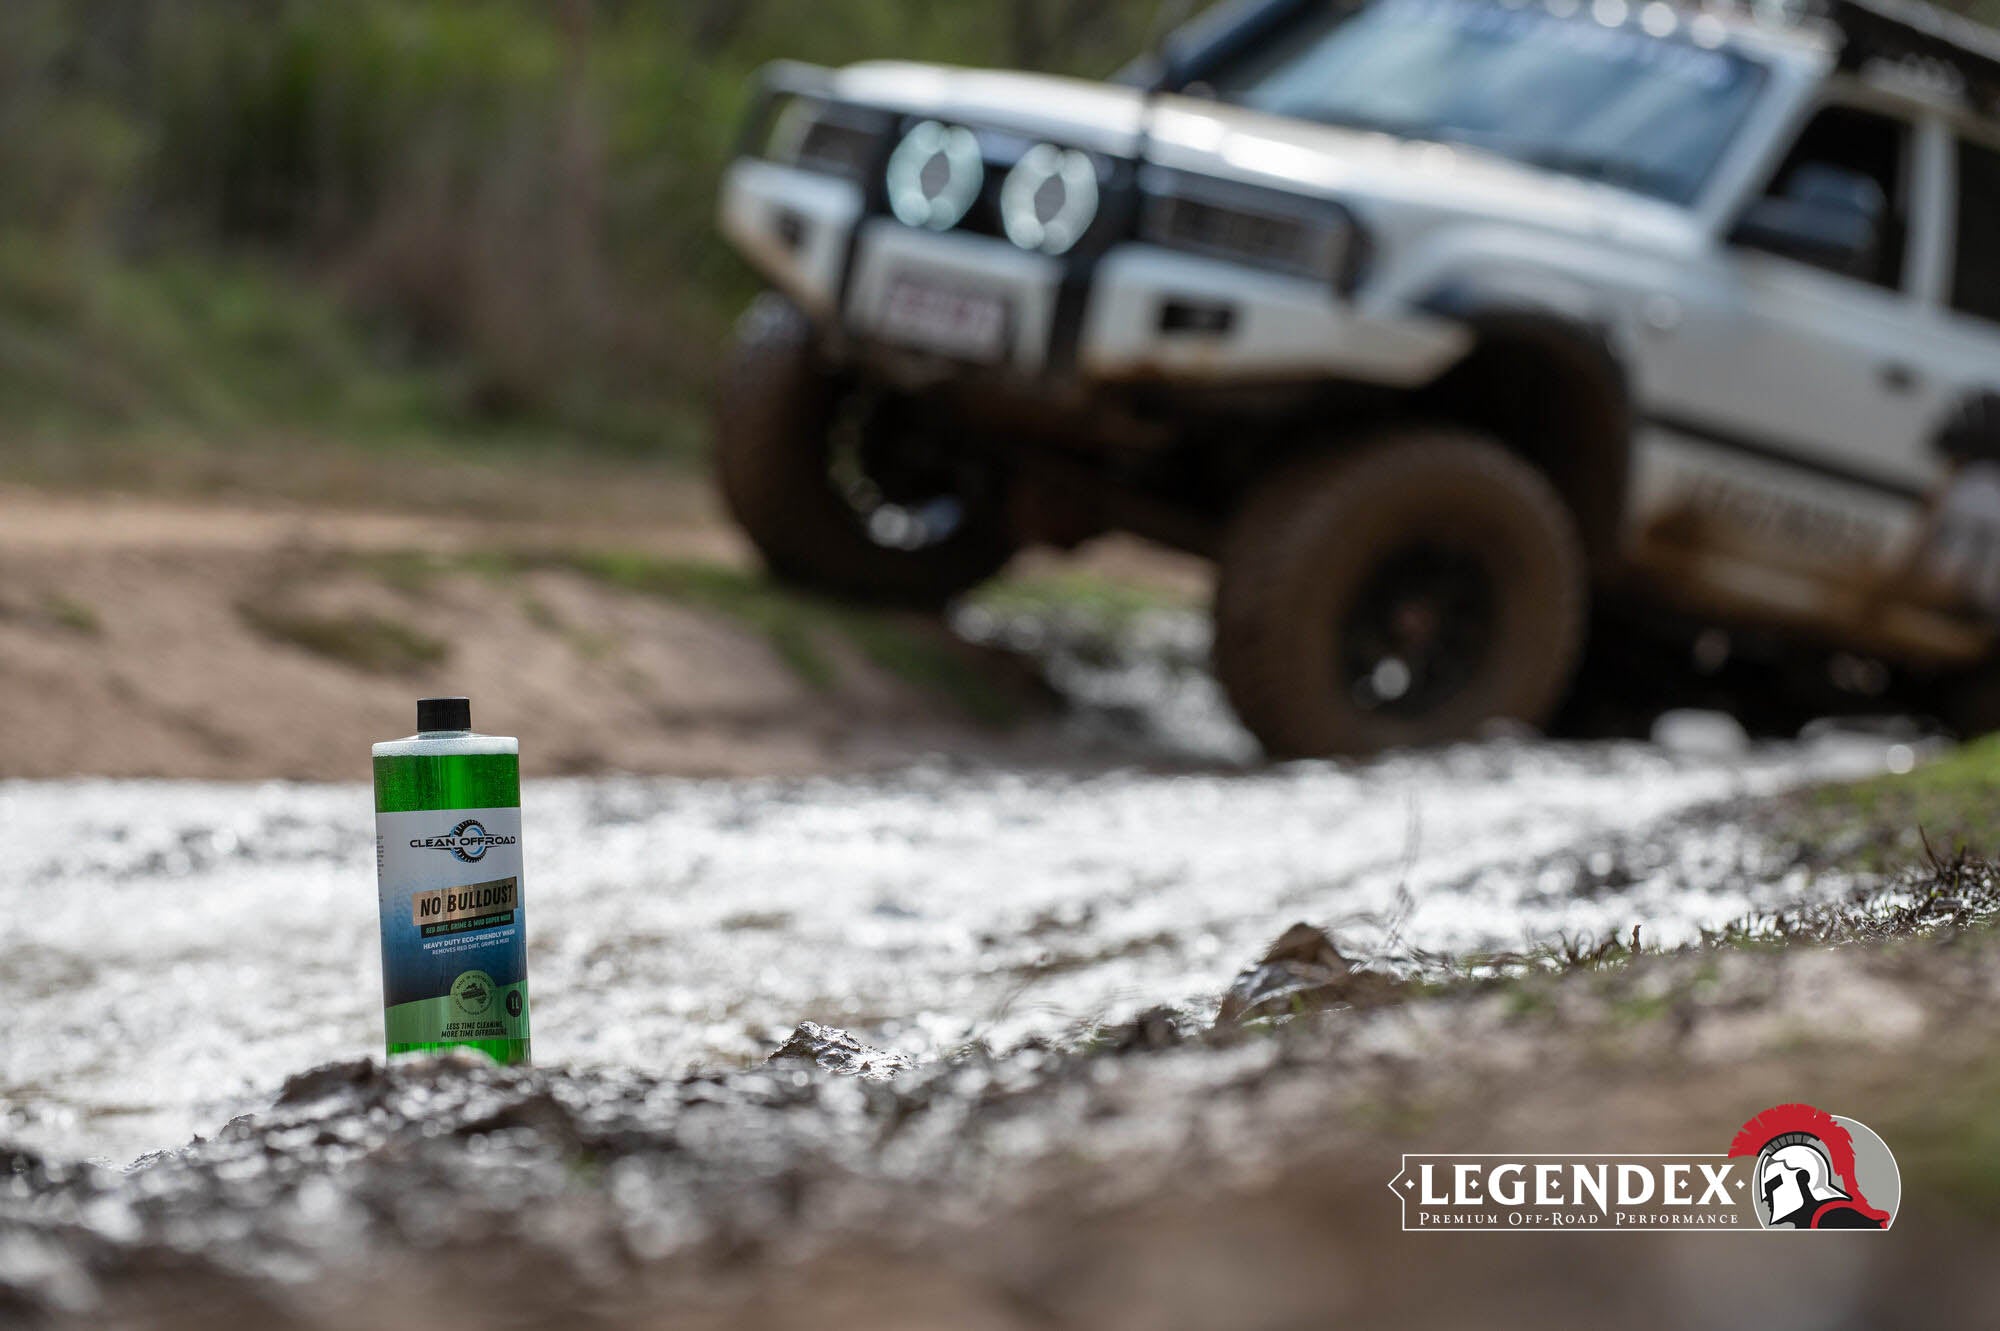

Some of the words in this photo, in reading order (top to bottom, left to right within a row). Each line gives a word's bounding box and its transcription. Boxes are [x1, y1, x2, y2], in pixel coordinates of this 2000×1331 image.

[409, 838, 456, 848] CLEAN
[459, 835, 516, 846] OFFROAD
[420, 896, 441, 917] NO
[447, 885, 513, 912] BULLDUST
[425, 926, 436, 934] RED
[450, 921, 467, 930] GRIME
[423, 942, 443, 950] HEAVY
[444, 938, 461, 946] DUTY
[462, 931, 501, 943] ECO-FRIENDLY
[432, 946, 456, 955] REMOVES
[461, 1022, 476, 1030] TIME
[441, 1030, 459, 1038] MORE
[459, 1029, 474, 1037] TIME
